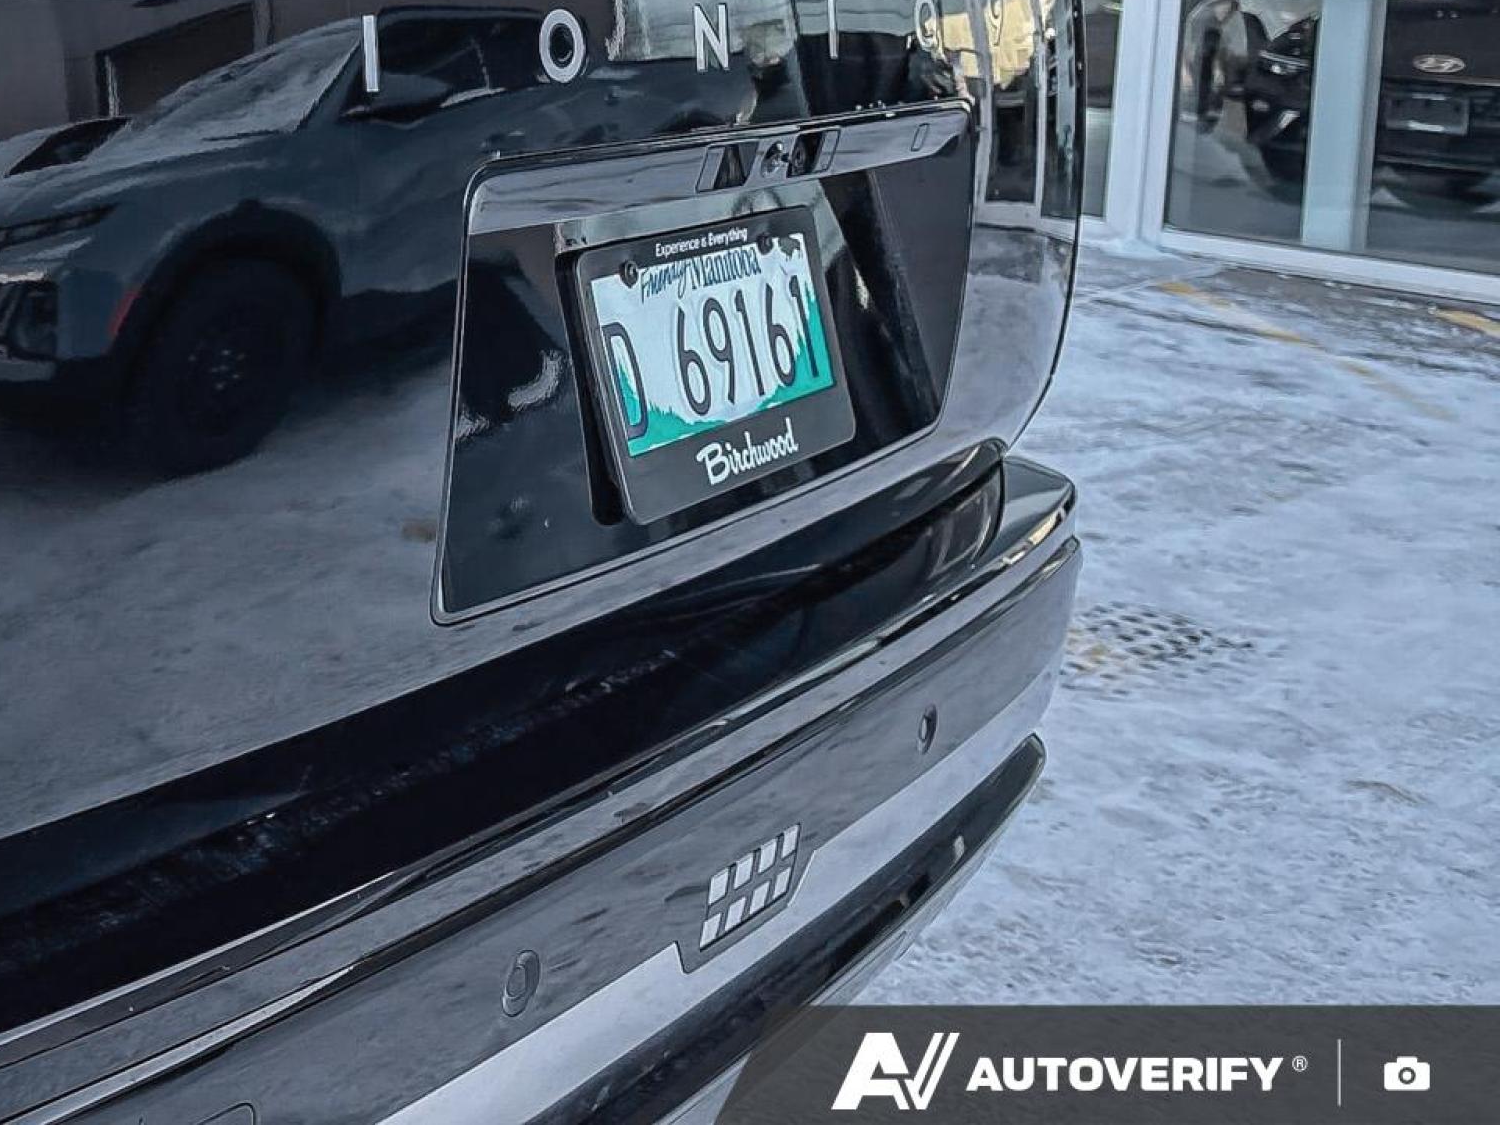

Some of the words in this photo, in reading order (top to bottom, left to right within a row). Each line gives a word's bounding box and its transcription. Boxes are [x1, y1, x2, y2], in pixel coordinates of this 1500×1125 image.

[655, 238, 700, 259] Experience
[707, 227, 748, 246] Everything
[677, 275, 819, 416] 69161
[696, 417, 799, 485] Birchwood
